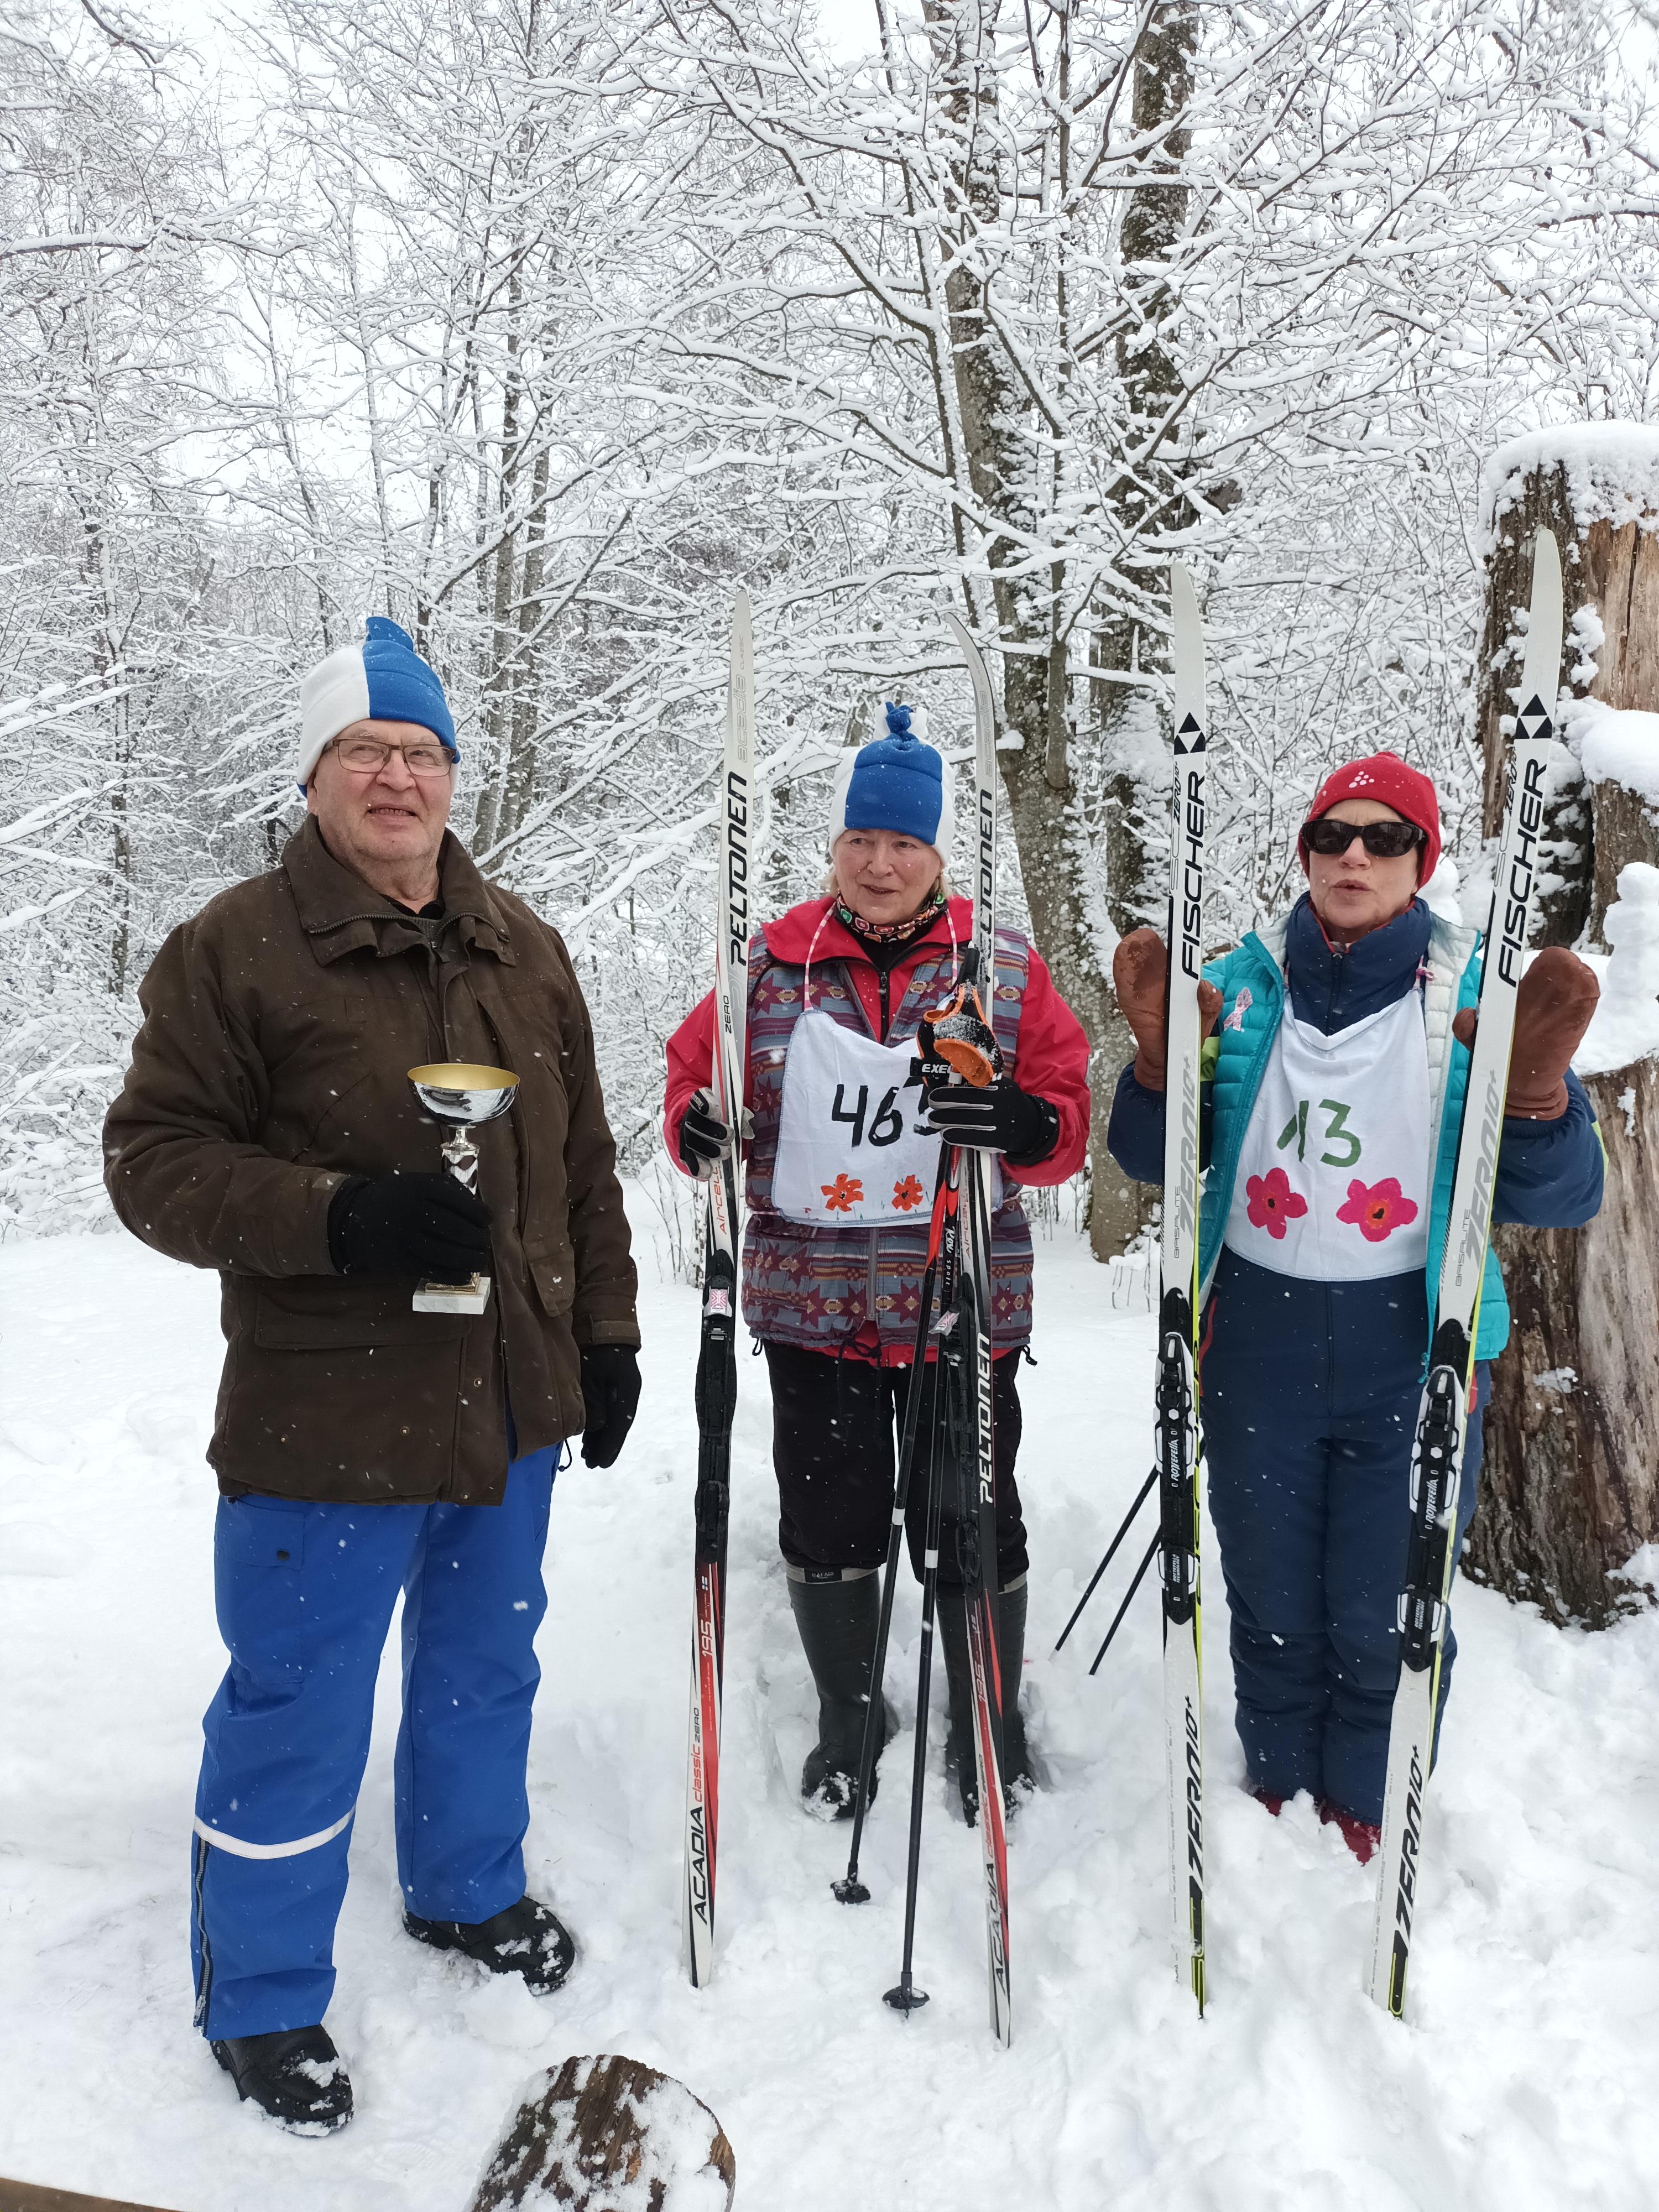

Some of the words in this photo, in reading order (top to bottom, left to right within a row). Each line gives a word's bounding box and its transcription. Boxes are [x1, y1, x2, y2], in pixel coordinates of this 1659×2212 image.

[728, 771, 747, 966] PELTONEN
[1182, 771, 1205, 980] FISCHER
[1498, 759, 1547, 988] FISCHER
[723, 995, 732, 1034] ZERO
[1276, 1099, 1361, 1167] 13
[977, 1332, 993, 1504] PELTONEN
[701, 1619, 713, 1657] 195
[692, 1744, 702, 1802] classic
[690, 1806, 708, 1925] ACADIA
